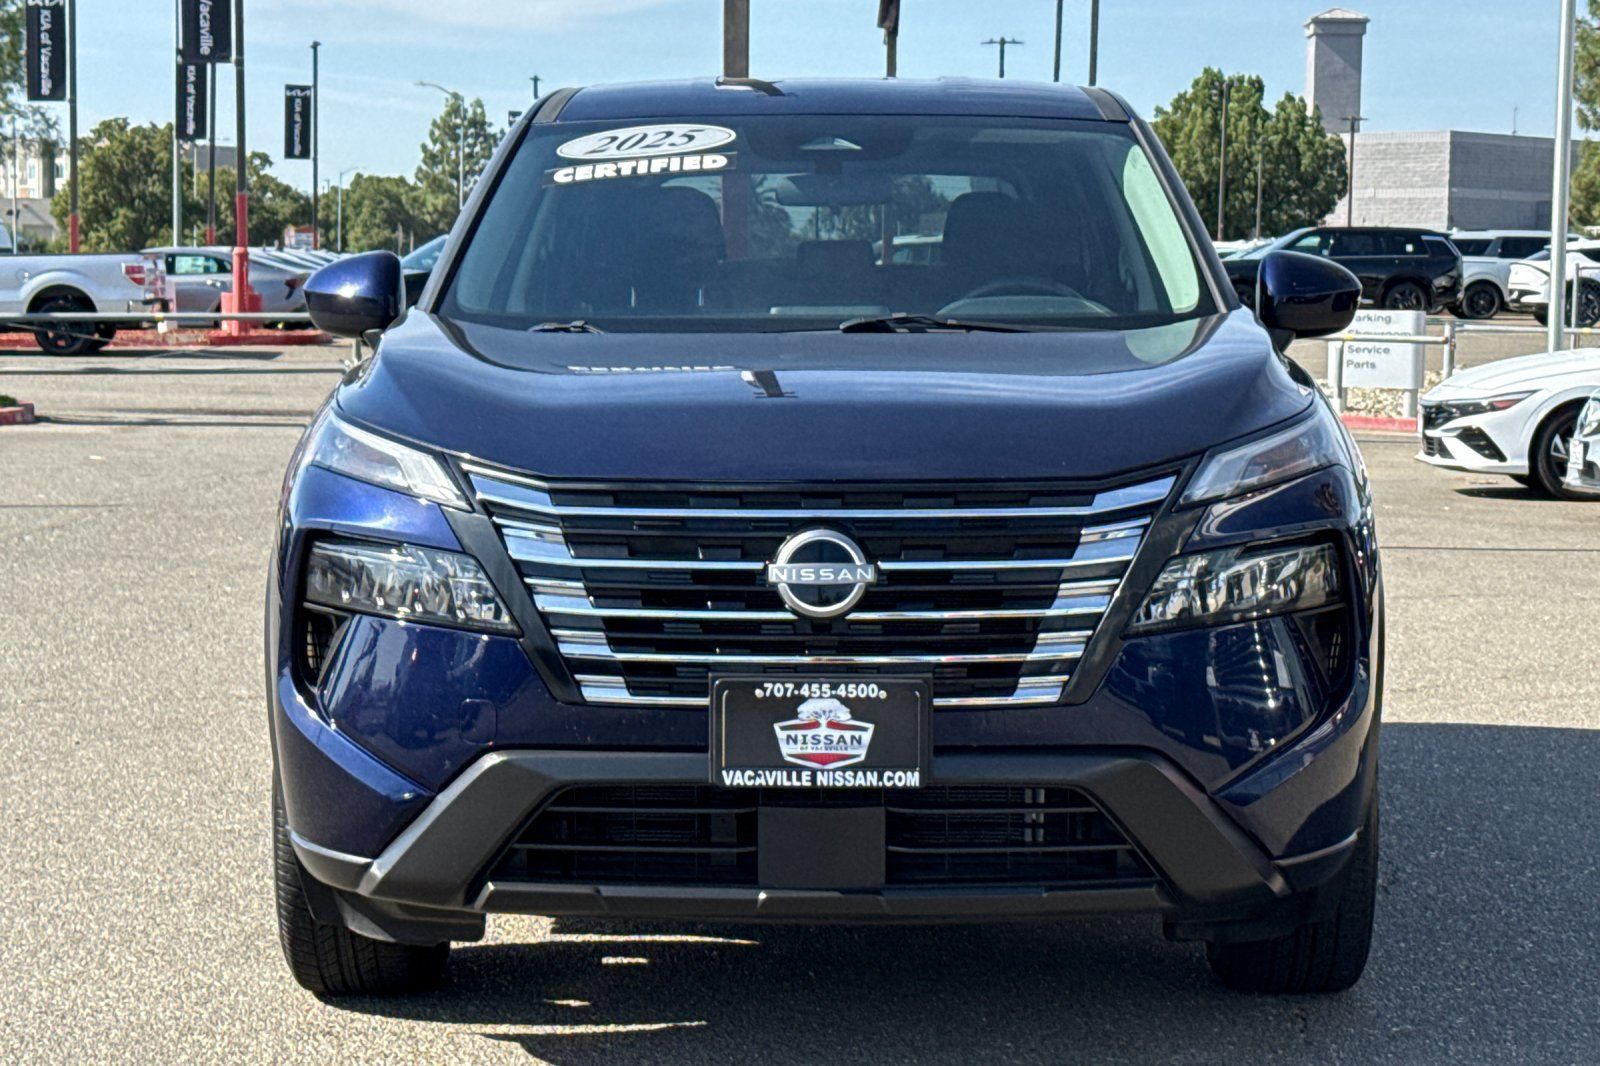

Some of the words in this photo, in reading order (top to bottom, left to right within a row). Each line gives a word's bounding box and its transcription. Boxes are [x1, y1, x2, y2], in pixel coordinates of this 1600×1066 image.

[584, 129, 705, 154] 2025
[553, 154, 728, 184] CERTIFIED
[1354, 314, 1392, 325] arking
[1347, 344, 1391, 354] Service
[1346, 359, 1376, 369] Parts
[773, 568, 872, 581] NISSAN
[786, 734, 862, 745] NISSAN
[722, 770, 812, 786] VACAVILLE
[816, 770, 920, 786] NISSAN.COM
